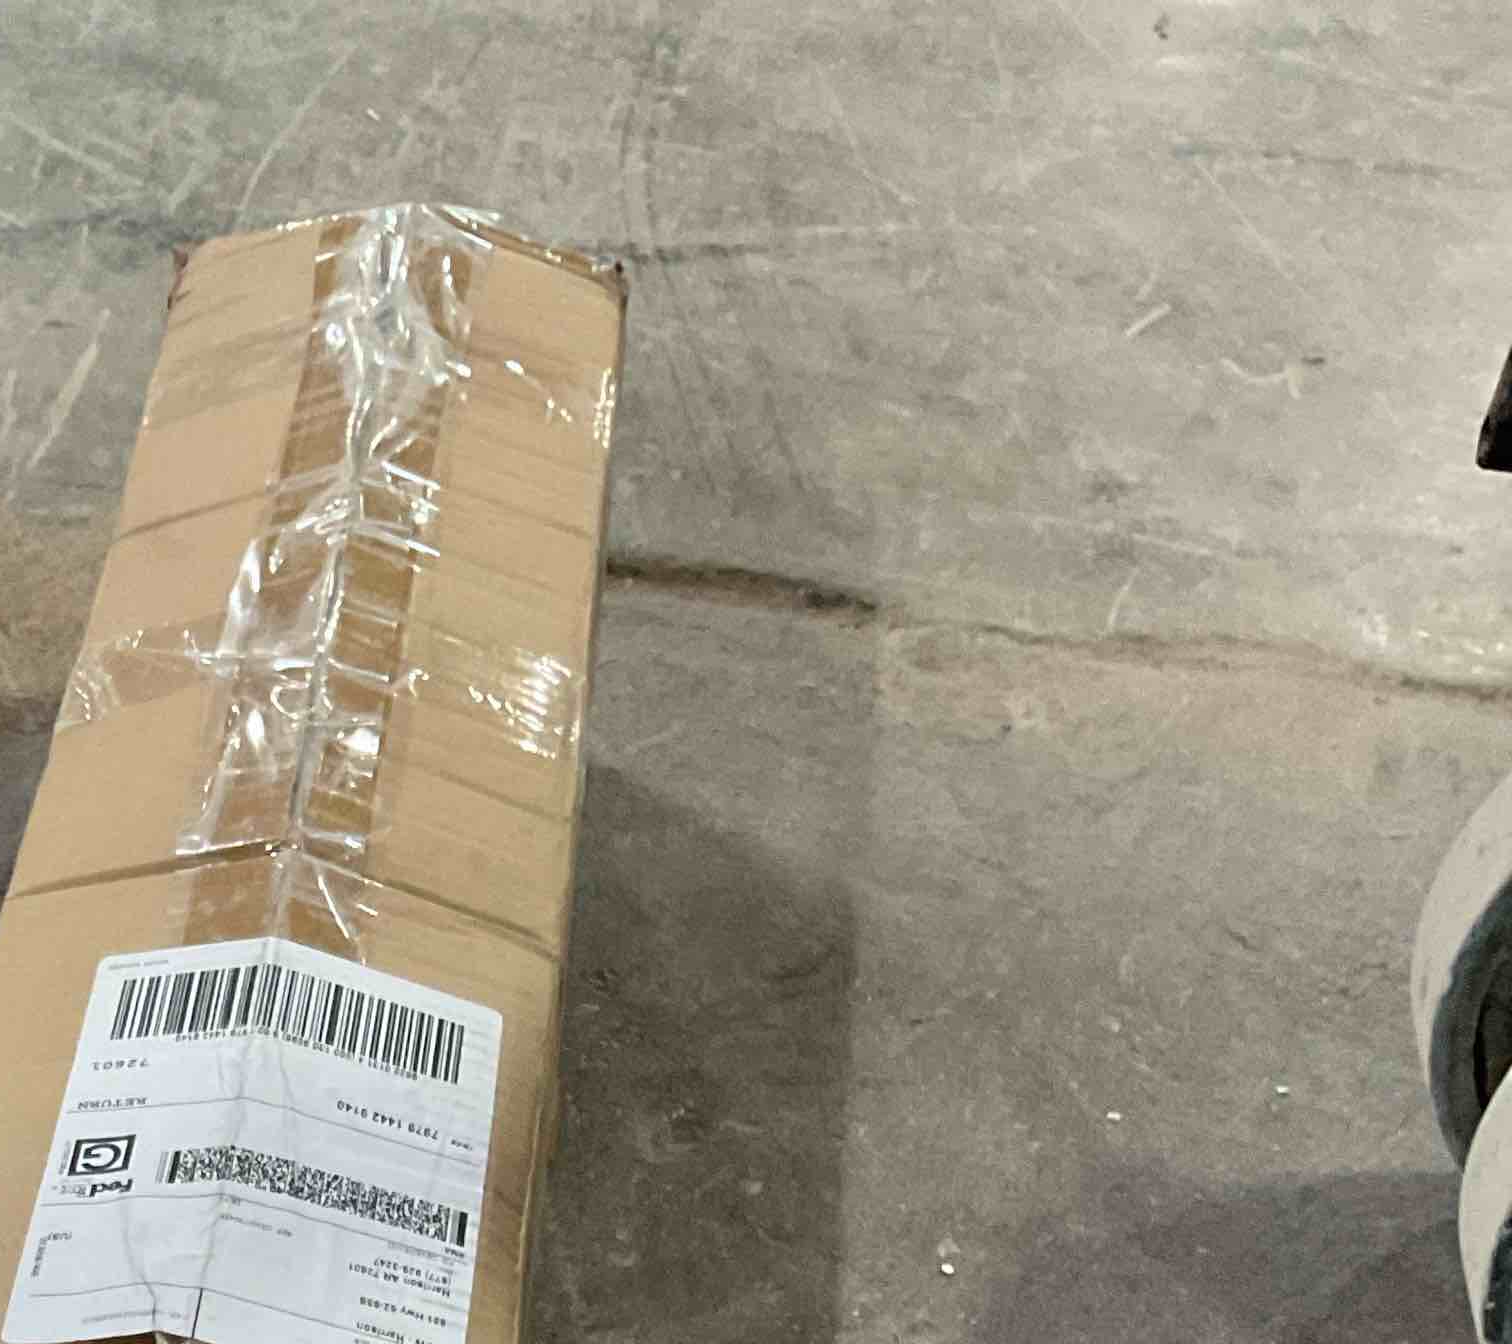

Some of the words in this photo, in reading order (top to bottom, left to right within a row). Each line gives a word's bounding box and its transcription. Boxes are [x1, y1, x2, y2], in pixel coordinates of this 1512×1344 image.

[91, 1058, 150, 1072] 72601
[78, 1098, 147, 1111] RETURN
[337, 1099, 369, 1119] 9140
[372, 1111, 402, 1130] 1442
[408, 1122, 439, 1141] 7979
[81, 1144, 122, 1172] G
[60, 1179, 134, 1199] FedEx
[349, 1262, 380, 1280] 72601
[383, 1272, 400, 1283] AR
[403, 1278, 451, 1299] Harrison
[355, 1322, 406, 1344] Harrison
